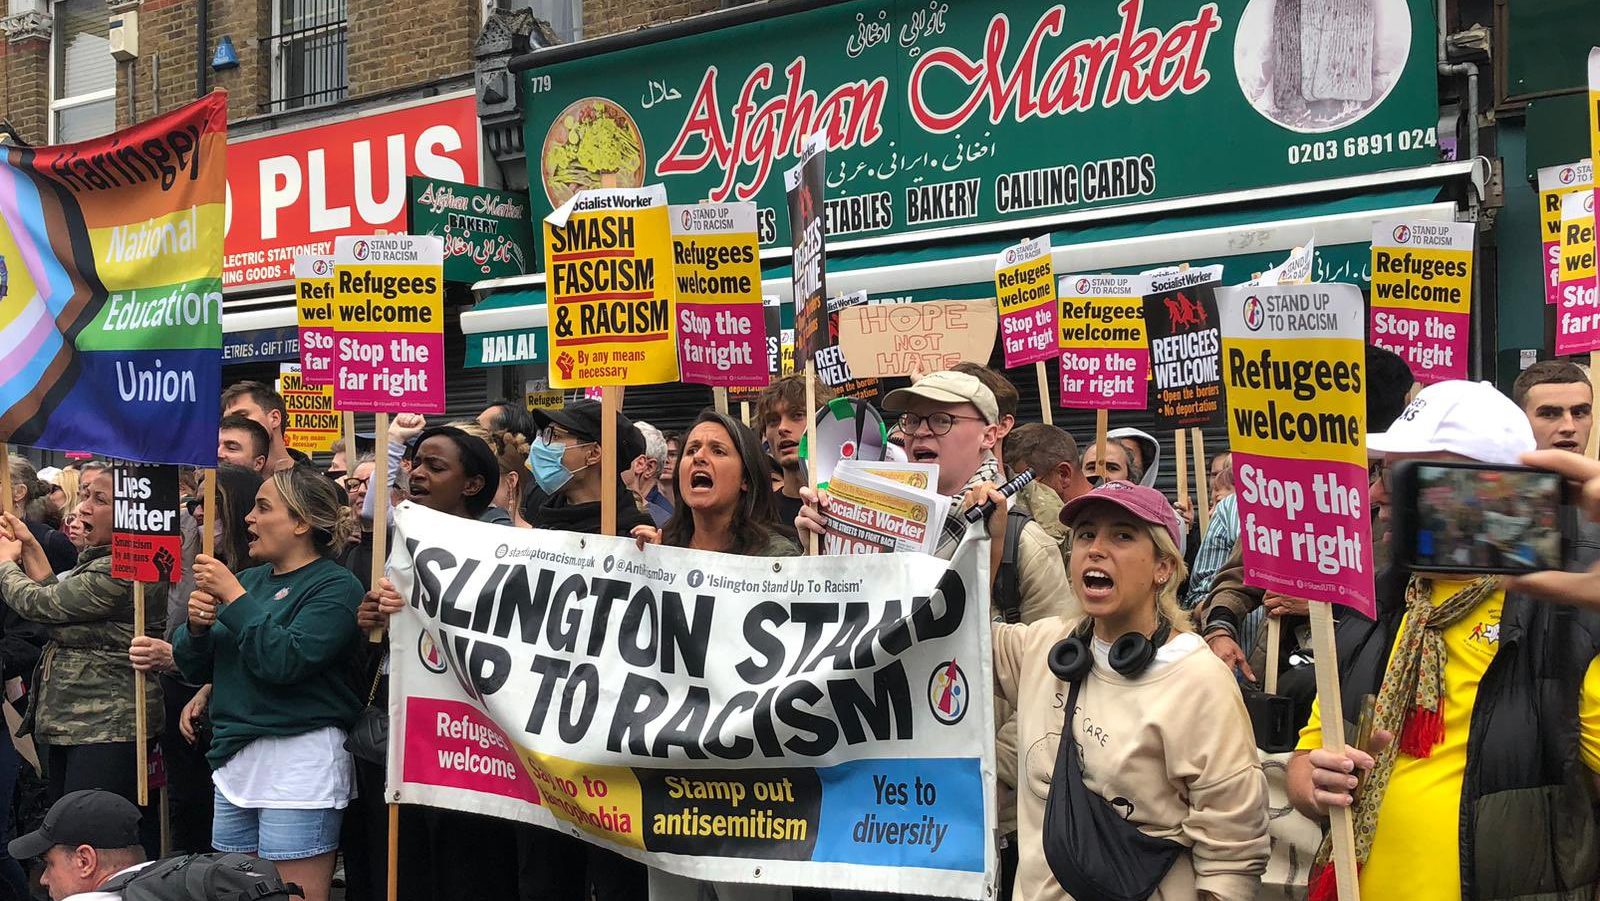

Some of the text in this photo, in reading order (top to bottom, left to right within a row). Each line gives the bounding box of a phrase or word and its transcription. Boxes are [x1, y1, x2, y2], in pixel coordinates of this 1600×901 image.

[531, 75, 552, 94] 779
[641, 80, 683, 109] حلال
[655, 0, 1222, 203] Afghan Market
[51, 118, 209, 192] Haringey
[1288, 126, 1438, 165] 0203 6891 024
[259, 124, 466, 241] PLUS
[824, 154, 1155, 237] ETABLES BAKERY CALLING CARDS
[417, 182, 469, 214] Afghan
[573, 195, 653, 211] ocialist Worker
[448, 213, 499, 235] BAKERY
[692, 208, 729, 219] STAND UP
[693, 219, 734, 230] TO RACISM
[105, 205, 198, 264] National
[551, 216, 635, 252] SMASH
[1412, 225, 1449, 236] STAND UP
[1412, 236, 1453, 246] TO RACISM
[223, 241, 333, 268] LECTRIC STATIONERY
[371, 240, 413, 250] STAND UP
[371, 251, 418, 261] TO RACISM
[673, 241, 754, 270] Refugees
[246, 265, 281, 281] GOODS
[553, 258, 655, 295] FASCISM
[998, 262, 1051, 289] Refugees
[1376, 252, 1467, 280] Refugees
[340, 270, 437, 299] Refugees
[677, 270, 751, 294] welcome
[1151, 275, 1186, 292] Socialist
[1185, 271, 1212, 286] Worker
[1376, 279, 1461, 304] welcome
[103, 284, 223, 331] Education
[1001, 283, 1051, 308] welcome
[1266, 294, 1330, 312] STAND UP
[339, 299, 432, 322] welcome
[555, 300, 669, 337] & RACISM
[859, 304, 968, 334] HOPE
[1004, 308, 1053, 335] Stop the
[1063, 301, 1145, 324] Refugees
[1268, 313, 1338, 331] TO RACISM
[1562, 312, 1591, 335] far
[680, 309, 752, 341] Stop the
[1062, 323, 1141, 341] welcome
[1375, 313, 1456, 341] Stop the
[221, 344, 254, 360] ETRIES
[261, 341, 283, 355] GIFT
[304, 331, 333, 349] Sto
[339, 337, 429, 368] Stop the
[481, 333, 538, 363] HALAL
[894, 332, 944, 352] NOT
[1006, 327, 1054, 354] far right
[1152, 328, 1219, 364] REFUGEES
[304, 353, 330, 370] far
[578, 350, 646, 365] By any means
[684, 341, 703, 362] far
[703, 341, 753, 371] right
[876, 352, 961, 375] HATE
[1062, 352, 1100, 375] Stop
[1105, 353, 1137, 371] the
[1408, 341, 1454, 369] right
[116, 359, 197, 402] Union
[339, 366, 368, 390] far
[373, 367, 428, 397] right
[578, 366, 628, 380] necessary
[1062, 374, 1135, 397] far right
[1154, 355, 1220, 389] WELCOME
[1229, 348, 1362, 401] Refugees
[283, 395, 332, 410] FASCISM
[528, 395, 564, 407] Refugees
[1163, 385, 1219, 404] Open the borders
[1164, 400, 1217, 416] No deportations
[295, 414, 338, 428] RACISM
[1233, 400, 1360, 447] welcome
[1239, 464, 1362, 520] Stop the
[114, 499, 176, 532] Matter
[828, 495, 876, 525] Socialist
[876, 510, 925, 539] Worker
[1245, 513, 1363, 574] far right
[761, 580, 789, 594] Stand
[790, 580, 804, 597] Up
[807, 579, 821, 593] To
[405, 537, 966, 685] ISLINGTON STAND
[525, 654, 600, 744] TO
[606, 659, 913, 760] RACISM
[1082, 717, 1110, 748] CARE
[438, 749, 518, 780] welcome
[555, 775, 578, 798] no
[582, 775, 608, 798] to
[664, 775, 794, 806] Stamp out
[873, 774, 936, 806] Yes to
[653, 806, 808, 841] antisemitism
[852, 813, 949, 853] diversity
